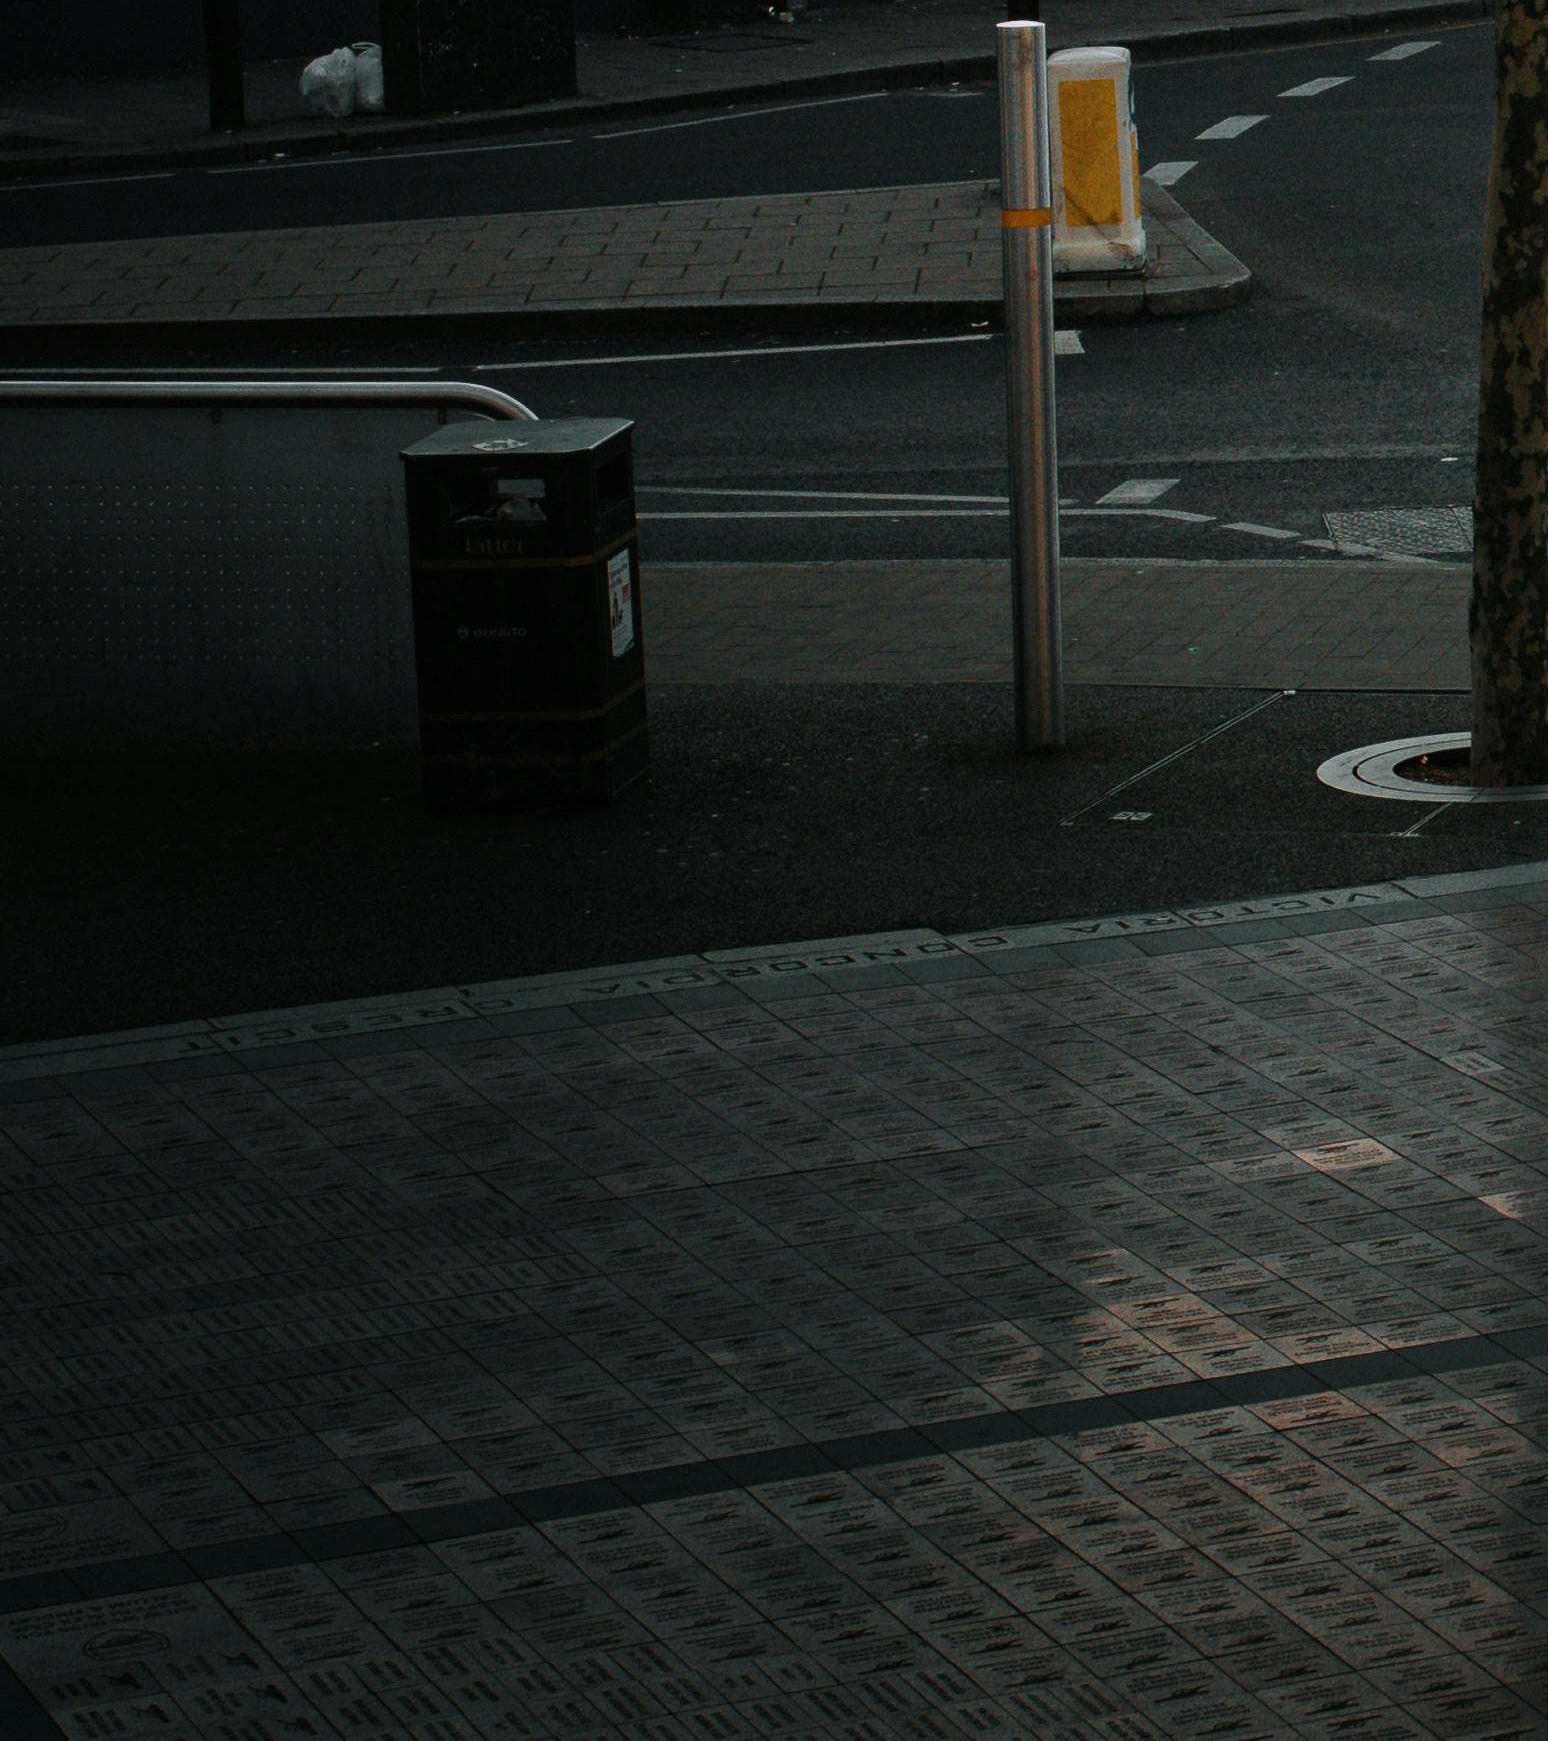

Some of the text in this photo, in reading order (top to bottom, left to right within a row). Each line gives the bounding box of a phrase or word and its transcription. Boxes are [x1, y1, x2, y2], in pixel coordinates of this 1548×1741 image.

[465, 536, 527, 556] Litter
[176, 890, 1382, 1052] VICTORIA CONCORDIA CRESCIT
